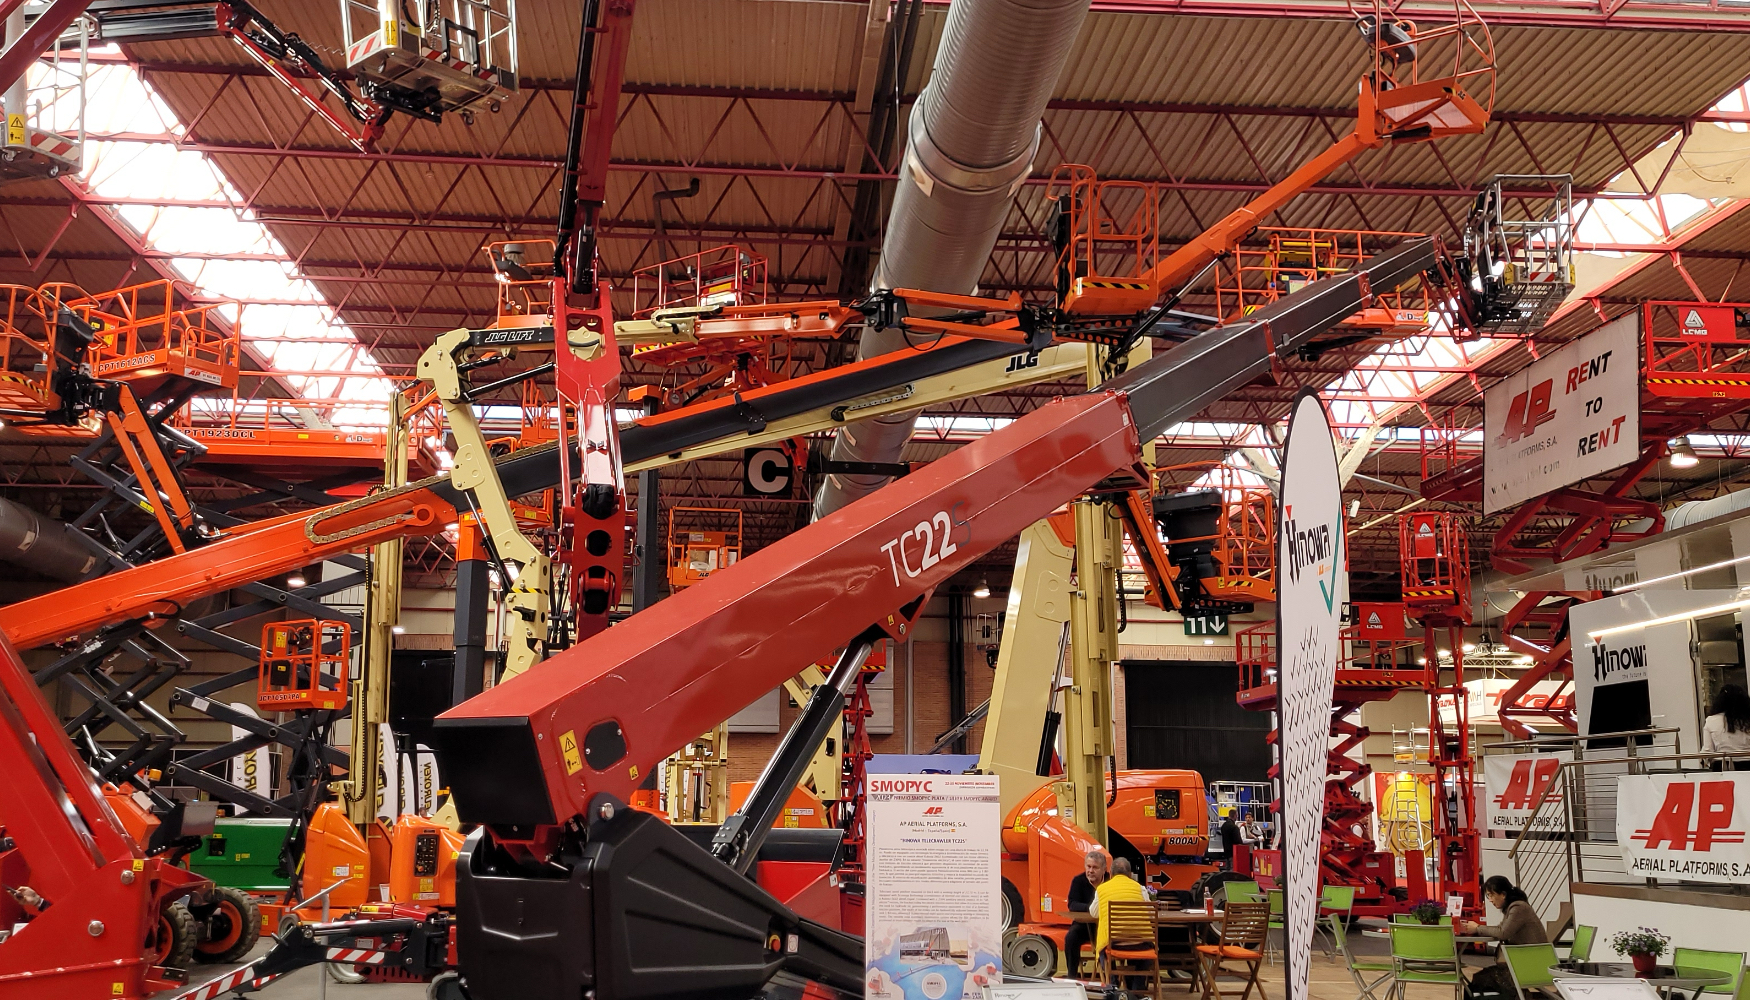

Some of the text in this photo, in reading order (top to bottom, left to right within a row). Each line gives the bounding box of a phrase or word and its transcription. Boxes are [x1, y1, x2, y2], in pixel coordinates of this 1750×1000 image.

[484, 330, 535, 343] JLG LIFT
[1682, 328, 1708, 336] LCMG
[1004, 352, 1039, 373] JLG
[1565, 350, 1612, 396] RENT
[1494, 378, 1557, 449] AP
[1585, 396, 1603, 417] TO
[1576, 415, 1627, 458] RENT
[748, 449, 789, 493] C
[880, 500, 972, 588] TC22S
[1186, 616, 1207, 634] 11
[870, 780, 933, 793] SMOPYC
[1493, 757, 1565, 810] AP
[922, 806, 944, 815] AP
[1630, 780, 1746, 852] AP
[1493, 815, 1513, 826] AERIAL
[1514, 816, 1552, 828] PLATORMS,
[1168, 836, 1199, 845] 800AJ
[1632, 857, 1667, 872] AERIAL
